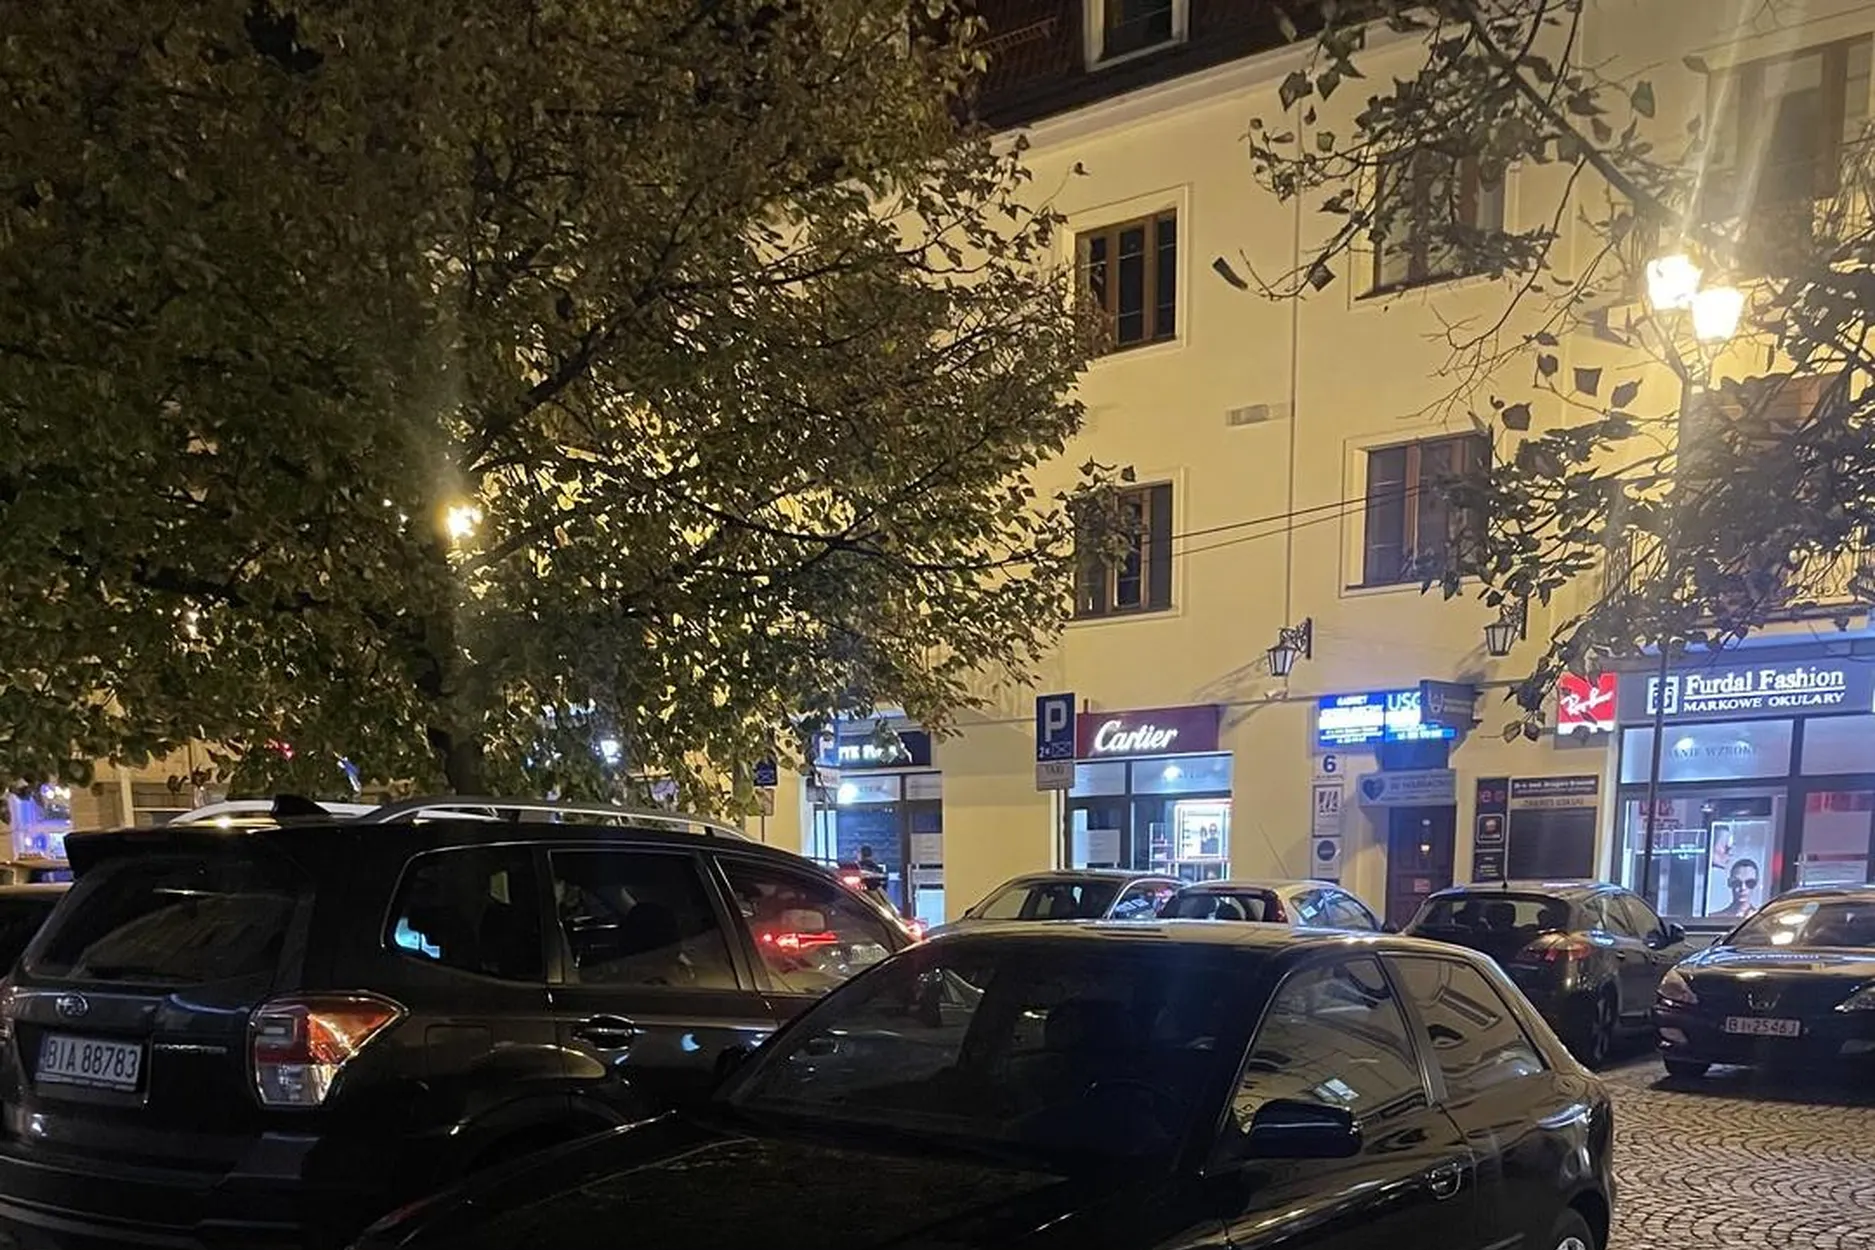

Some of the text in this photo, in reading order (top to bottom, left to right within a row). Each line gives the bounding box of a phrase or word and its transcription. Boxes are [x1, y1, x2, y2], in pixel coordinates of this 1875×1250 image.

[1684, 667, 1844, 695] Furdal Fashion
[1684, 692, 1845, 712] MARKOWE OKULARY
[1044, 699, 1068, 742] P
[1094, 719, 1179, 752] Cartier
[1323, 755, 1336, 773] 6
[47, 1039, 138, 1079] BIA 88783
